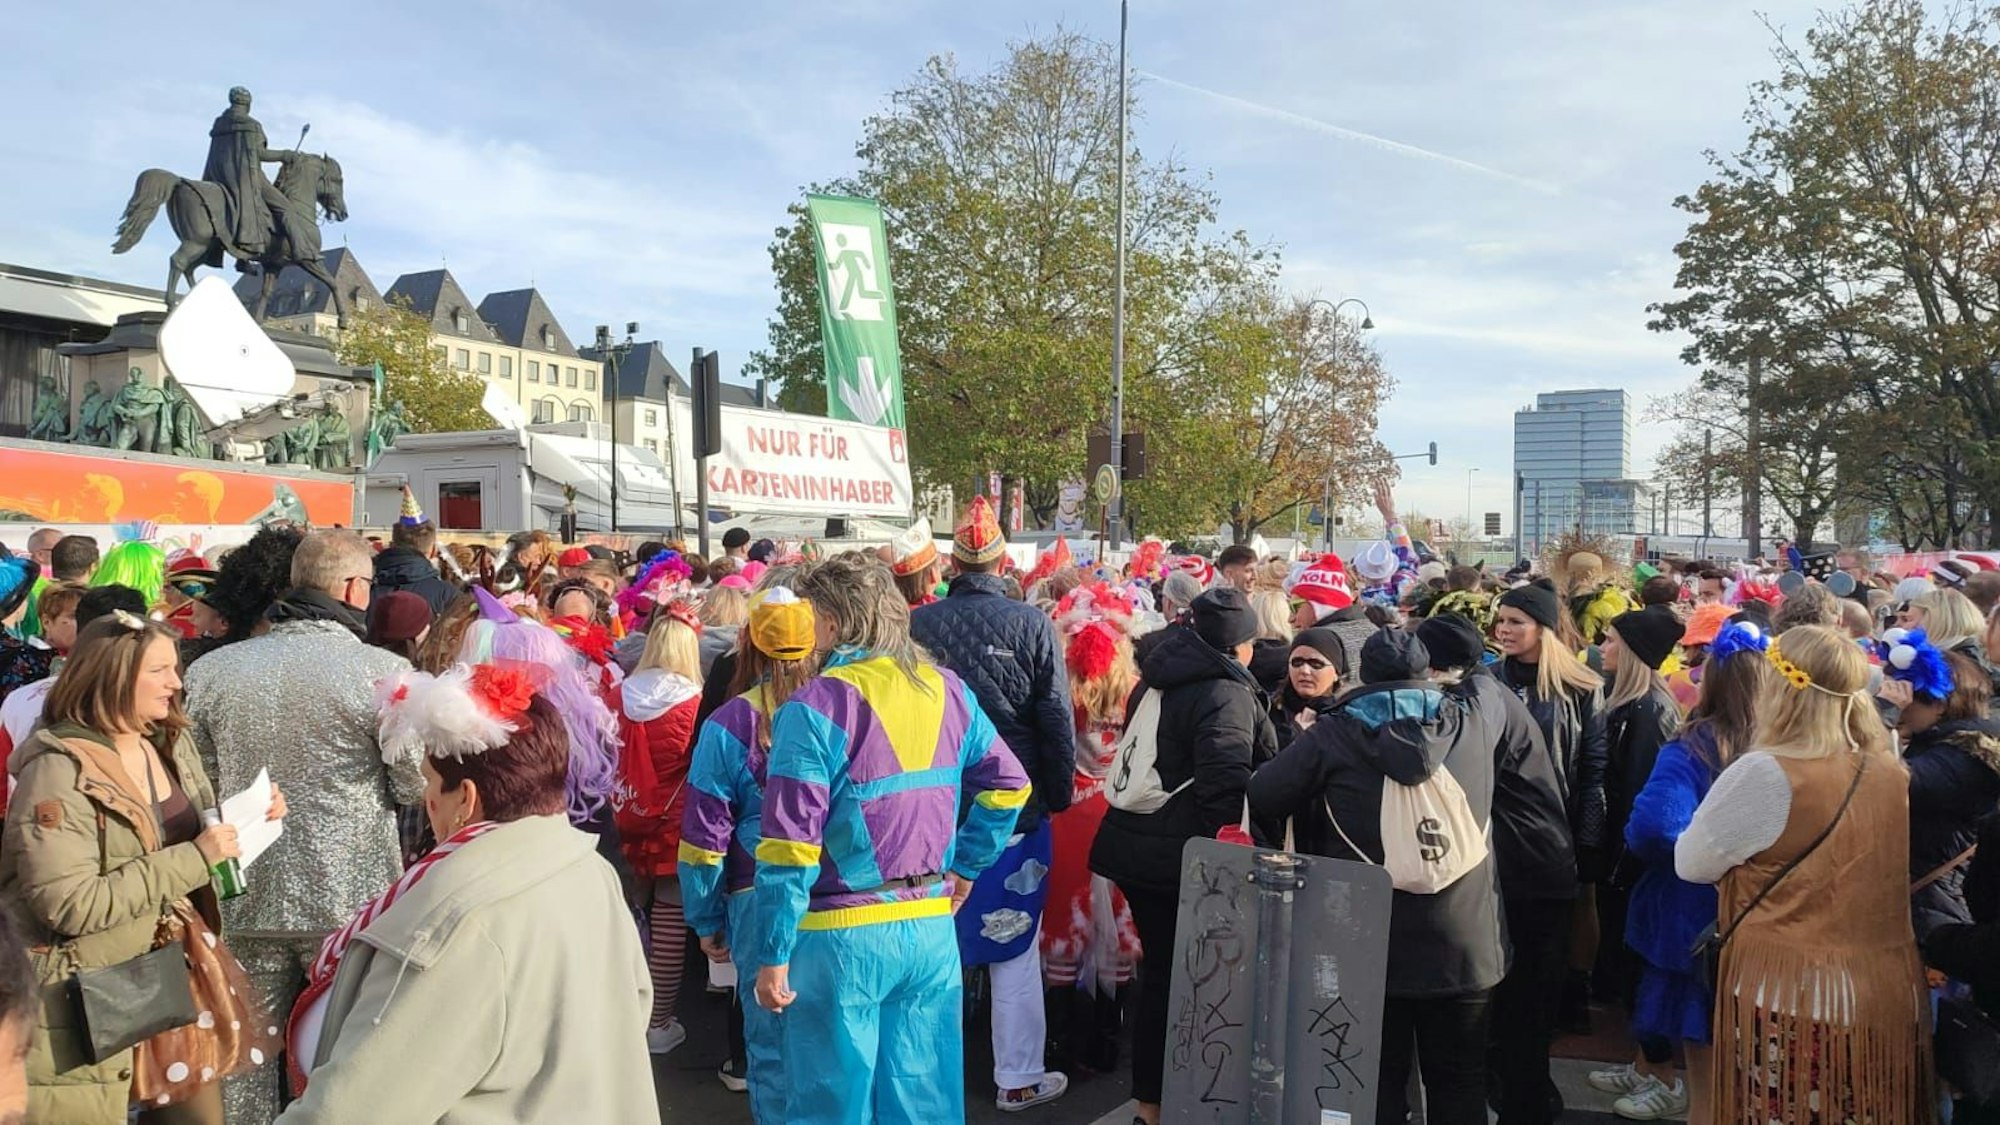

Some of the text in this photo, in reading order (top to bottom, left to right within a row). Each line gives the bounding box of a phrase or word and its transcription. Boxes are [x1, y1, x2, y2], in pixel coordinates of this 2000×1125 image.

[747, 425, 849, 461] NUR FÜR
[1299, 573, 1343, 588] KÖLN
